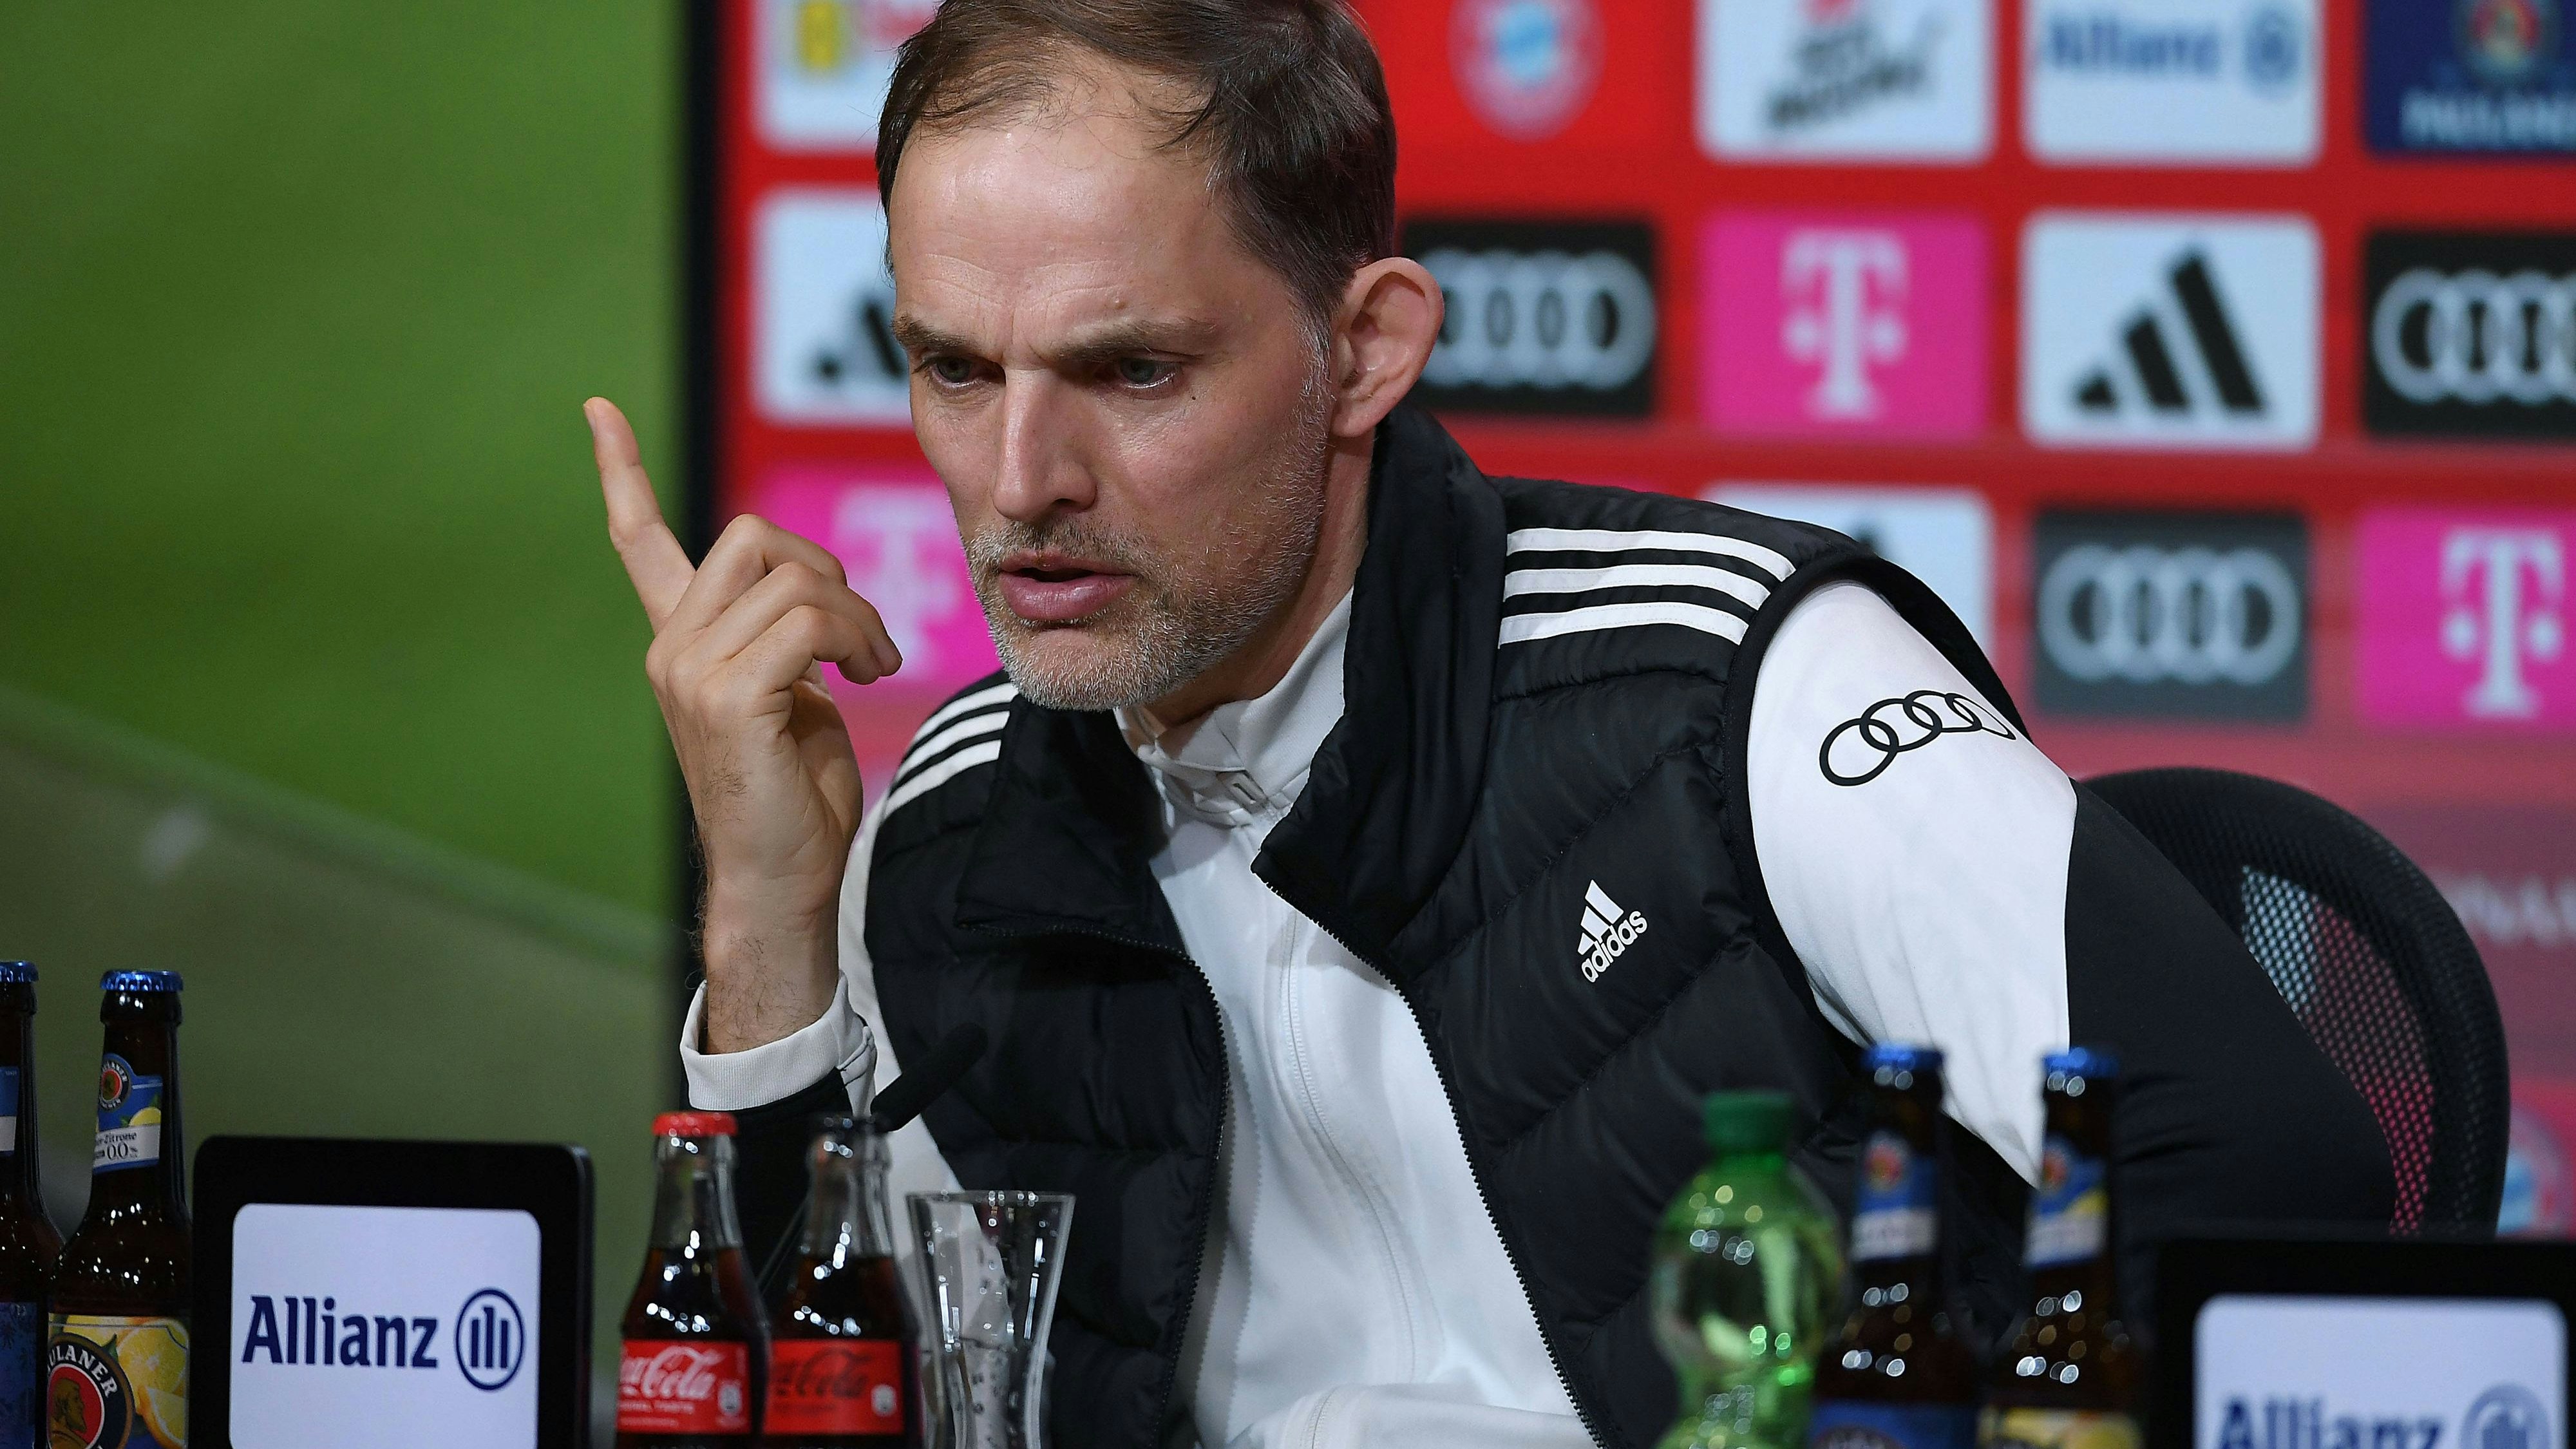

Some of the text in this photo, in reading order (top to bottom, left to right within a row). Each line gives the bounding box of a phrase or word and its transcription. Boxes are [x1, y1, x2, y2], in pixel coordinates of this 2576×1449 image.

[1581, 911, 1648, 983] adidas
[242, 1296, 439, 1368] Allianz
[48, 1344, 118, 1398] ULANER
